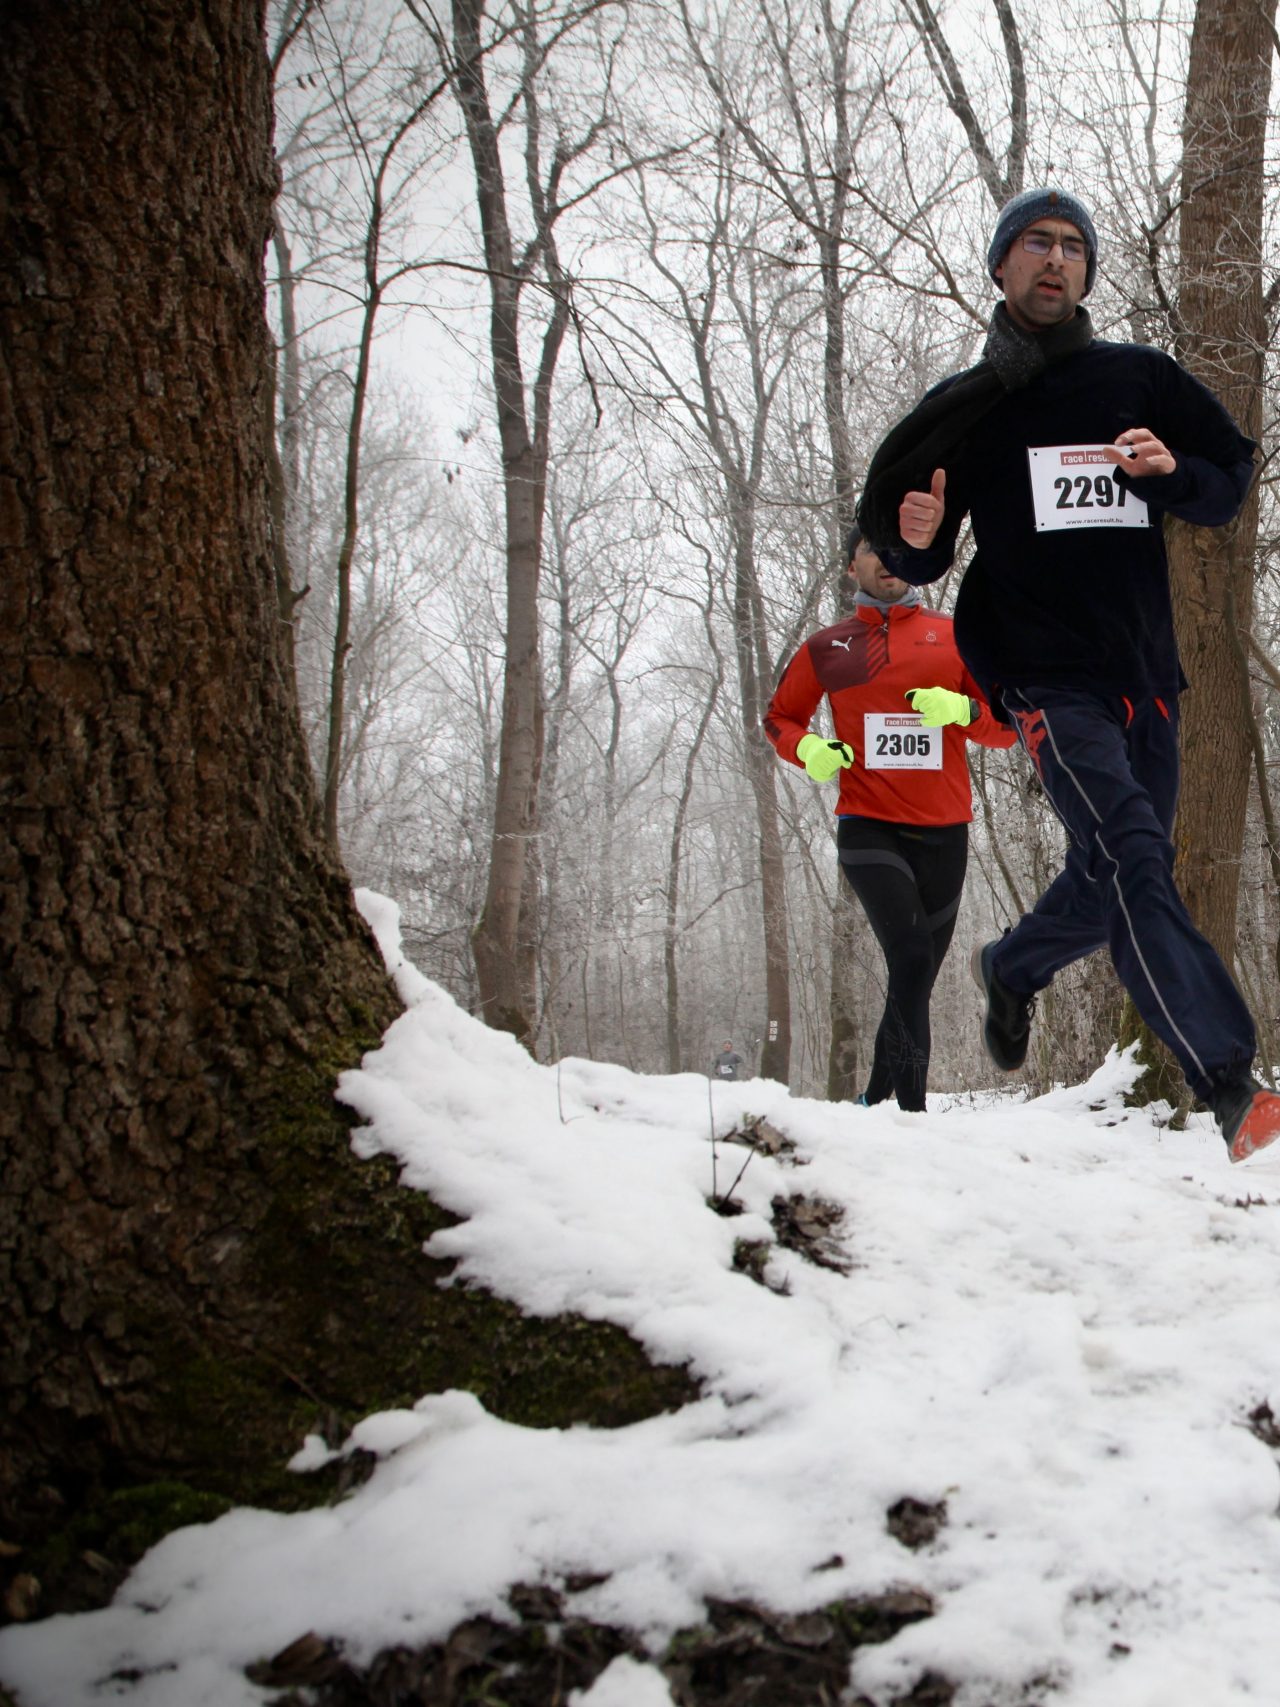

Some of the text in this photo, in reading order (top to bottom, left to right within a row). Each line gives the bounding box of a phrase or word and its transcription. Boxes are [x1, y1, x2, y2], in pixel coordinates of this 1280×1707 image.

[1063, 453, 1110, 464] race resu
[876, 733, 931, 756] 2305
